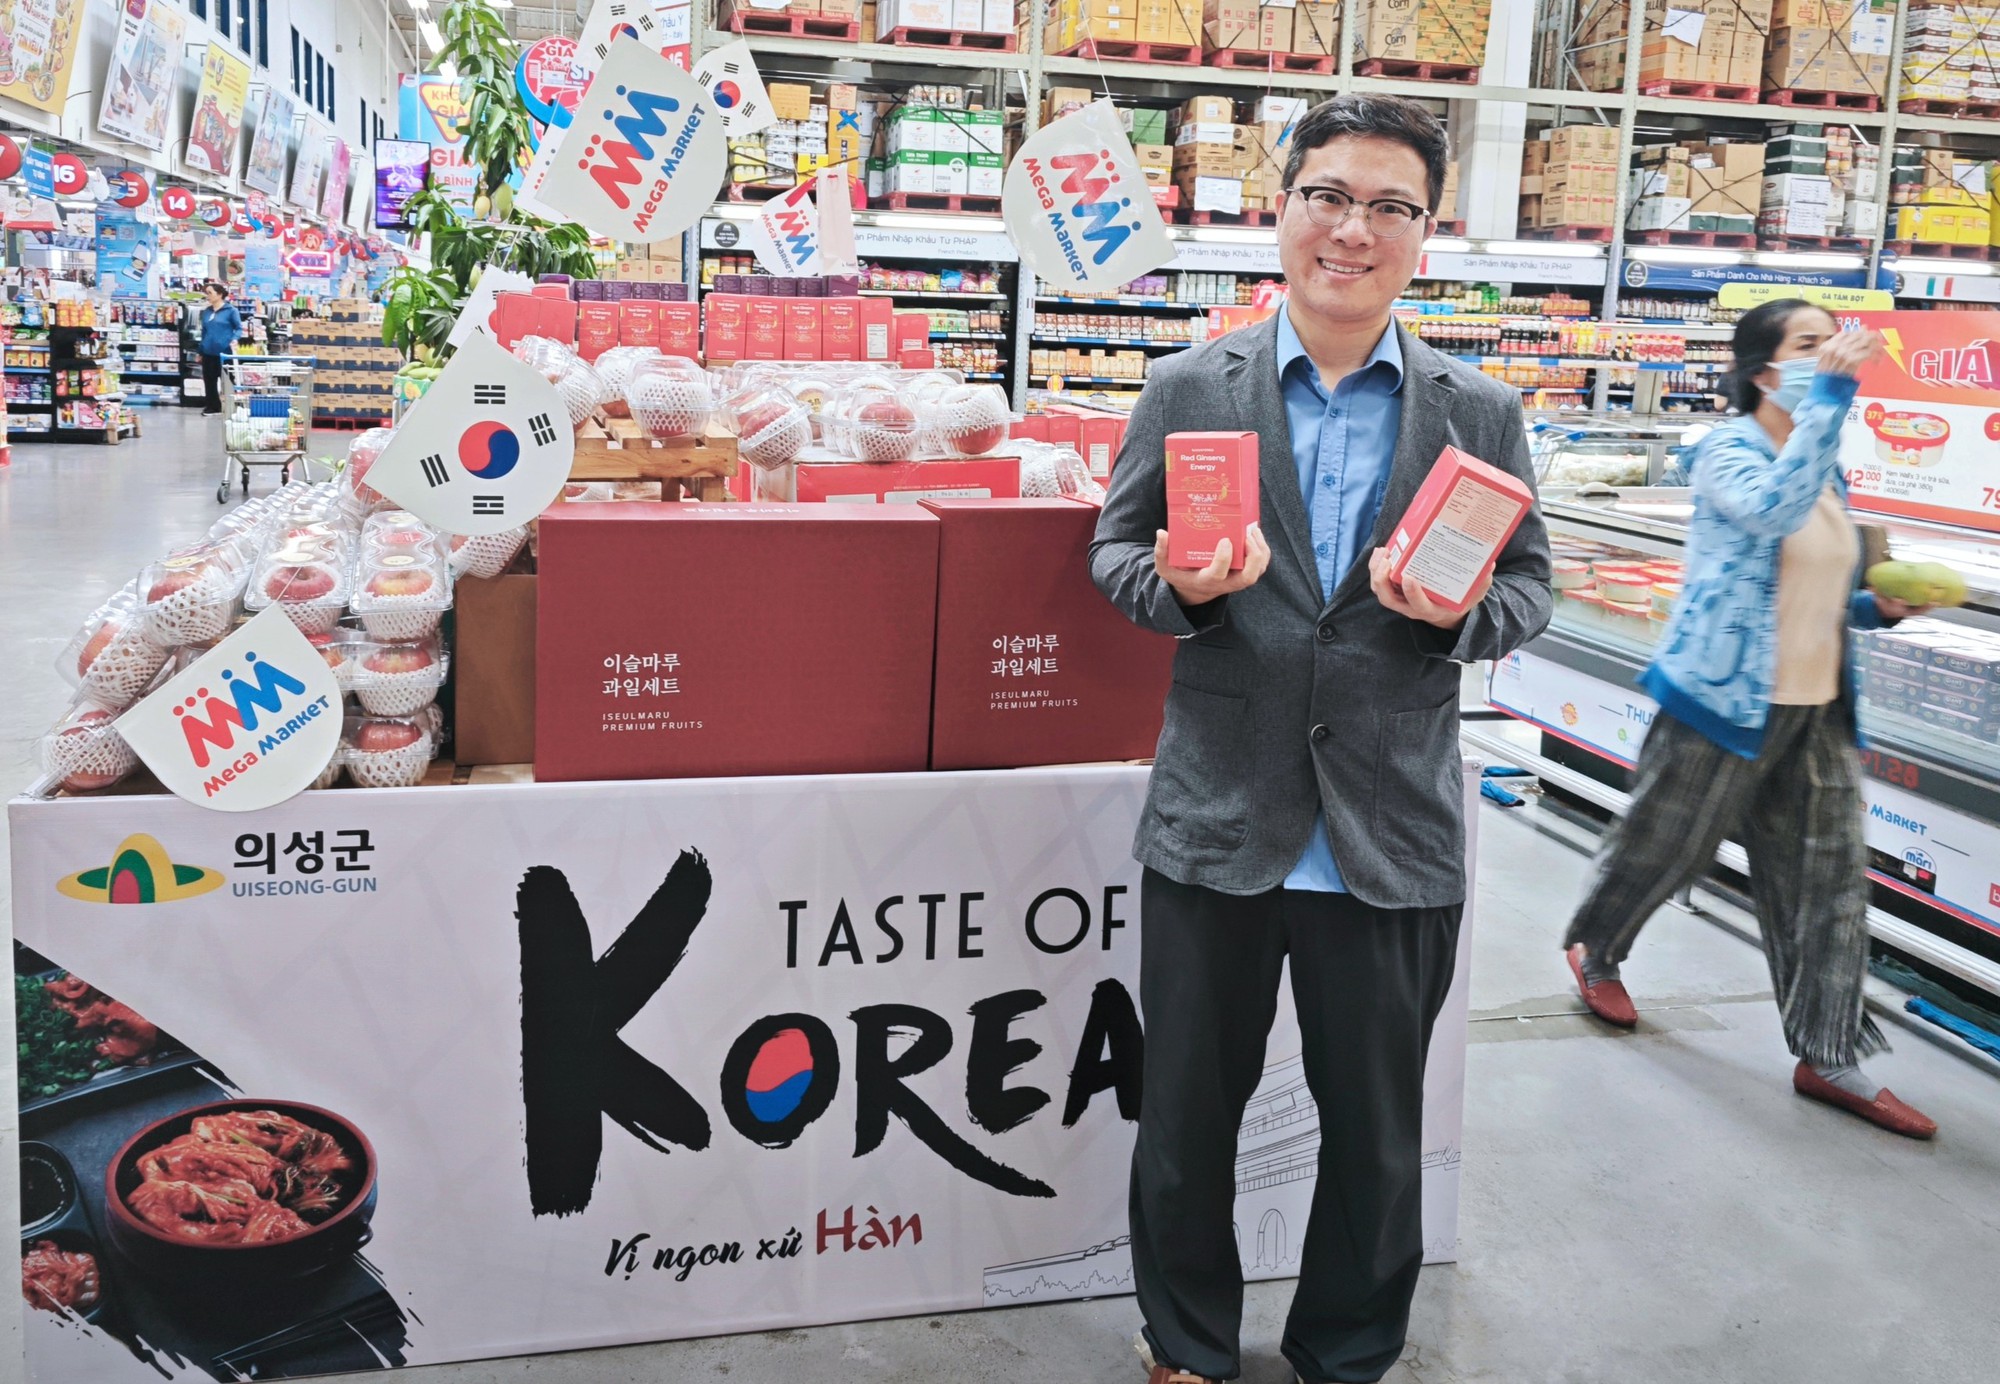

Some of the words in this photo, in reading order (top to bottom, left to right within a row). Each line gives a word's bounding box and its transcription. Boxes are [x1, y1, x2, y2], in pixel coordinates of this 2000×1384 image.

[1385, 33, 1407, 46] Corn
[53, 165, 76, 184] 16
[444, 174, 473, 187] BÌNH
[167, 195, 188, 211] 14
[1745, 272, 1759, 281] Cho
[1910, 339, 1993, 383] GIÁ
[1196, 454, 1226, 463] Ginseng
[1190, 463, 1216, 472] Energy
[992, 633, 1060, 655] 이슬마루
[603, 652, 681, 674] 이슬마루
[990, 656, 1059, 678] 과일세트
[1950, 659, 1968, 668] GIANT
[601, 676, 681, 698] 과일세트
[990, 689, 1050, 699] ISEULMARU
[990, 701, 1037, 710] PREMIUM
[1042, 698, 1078, 707] FRUITS
[602, 711, 670, 721] ISEULMARU
[602, 722, 656, 732] PREMIUM
[661, 720, 703, 730] FRUITS
[233, 829, 375, 875] 의성군
[232, 877, 377, 898] UISEONG-GUN
[778, 892, 985, 968] TASTE
[1025, 885, 1128, 955] OF
[604, 1232, 651, 1281] Vị
[652, 1241, 745, 1282] ngon
[756, 1226, 803, 1260] xứ
[816, 1204, 923, 1256] Hàn
